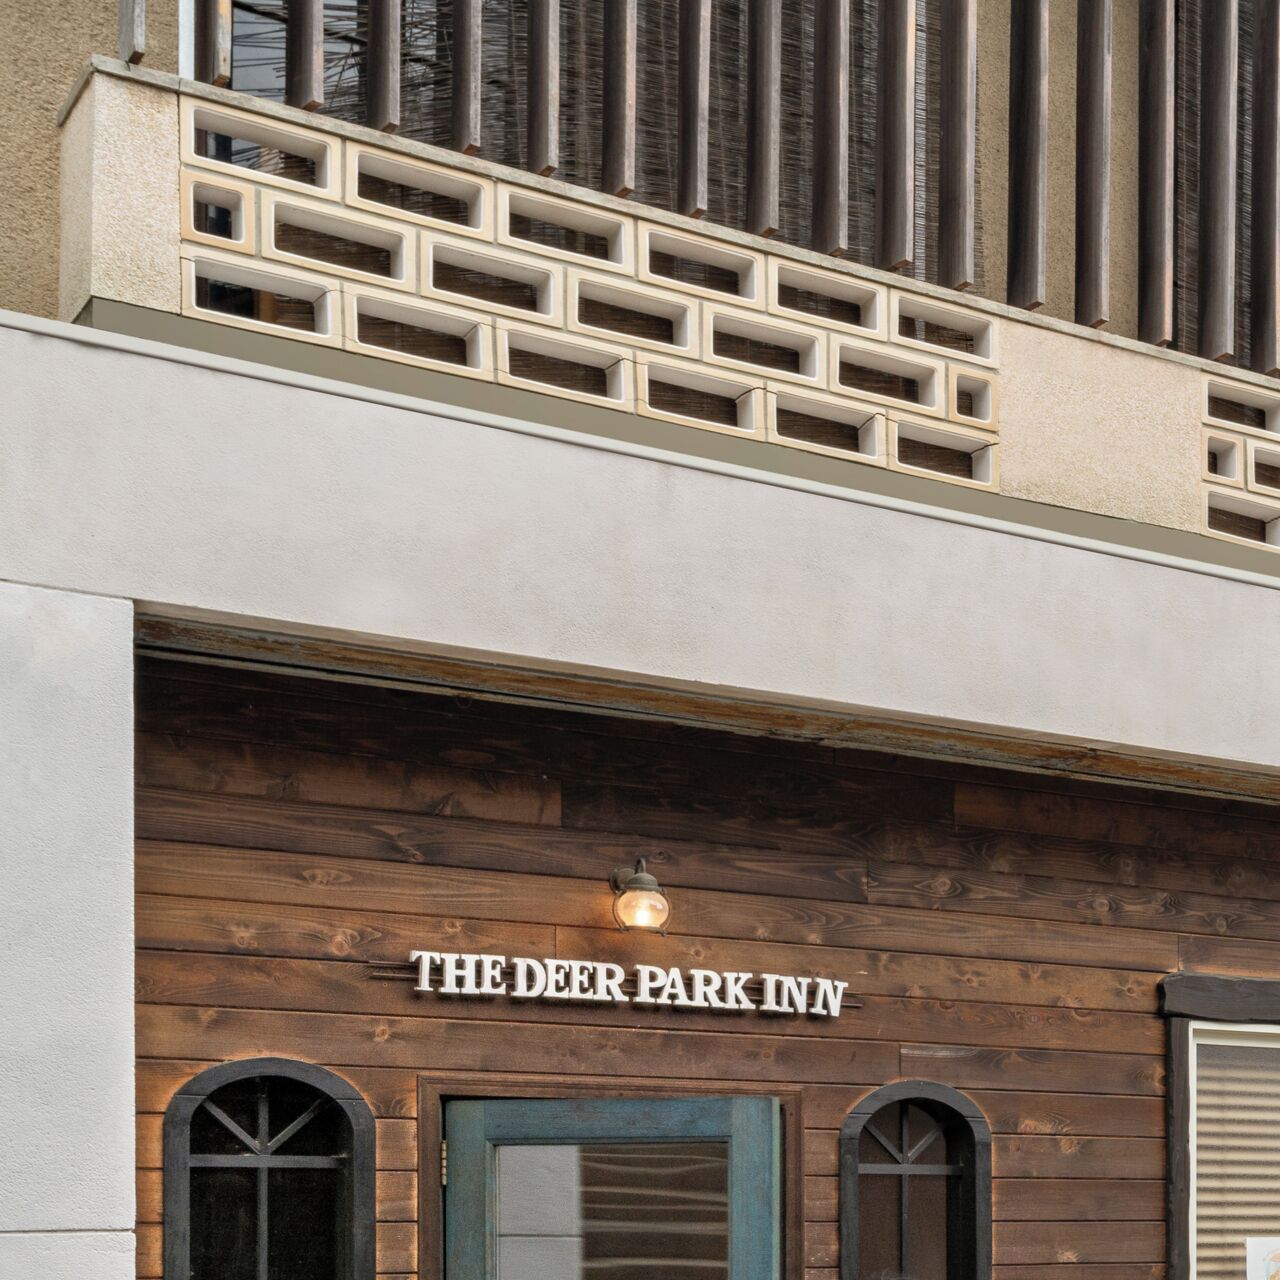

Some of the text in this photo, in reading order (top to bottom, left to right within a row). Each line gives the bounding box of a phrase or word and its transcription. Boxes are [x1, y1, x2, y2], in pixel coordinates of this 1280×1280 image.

[409, 949, 849, 1017] THE DEER PARK INN
